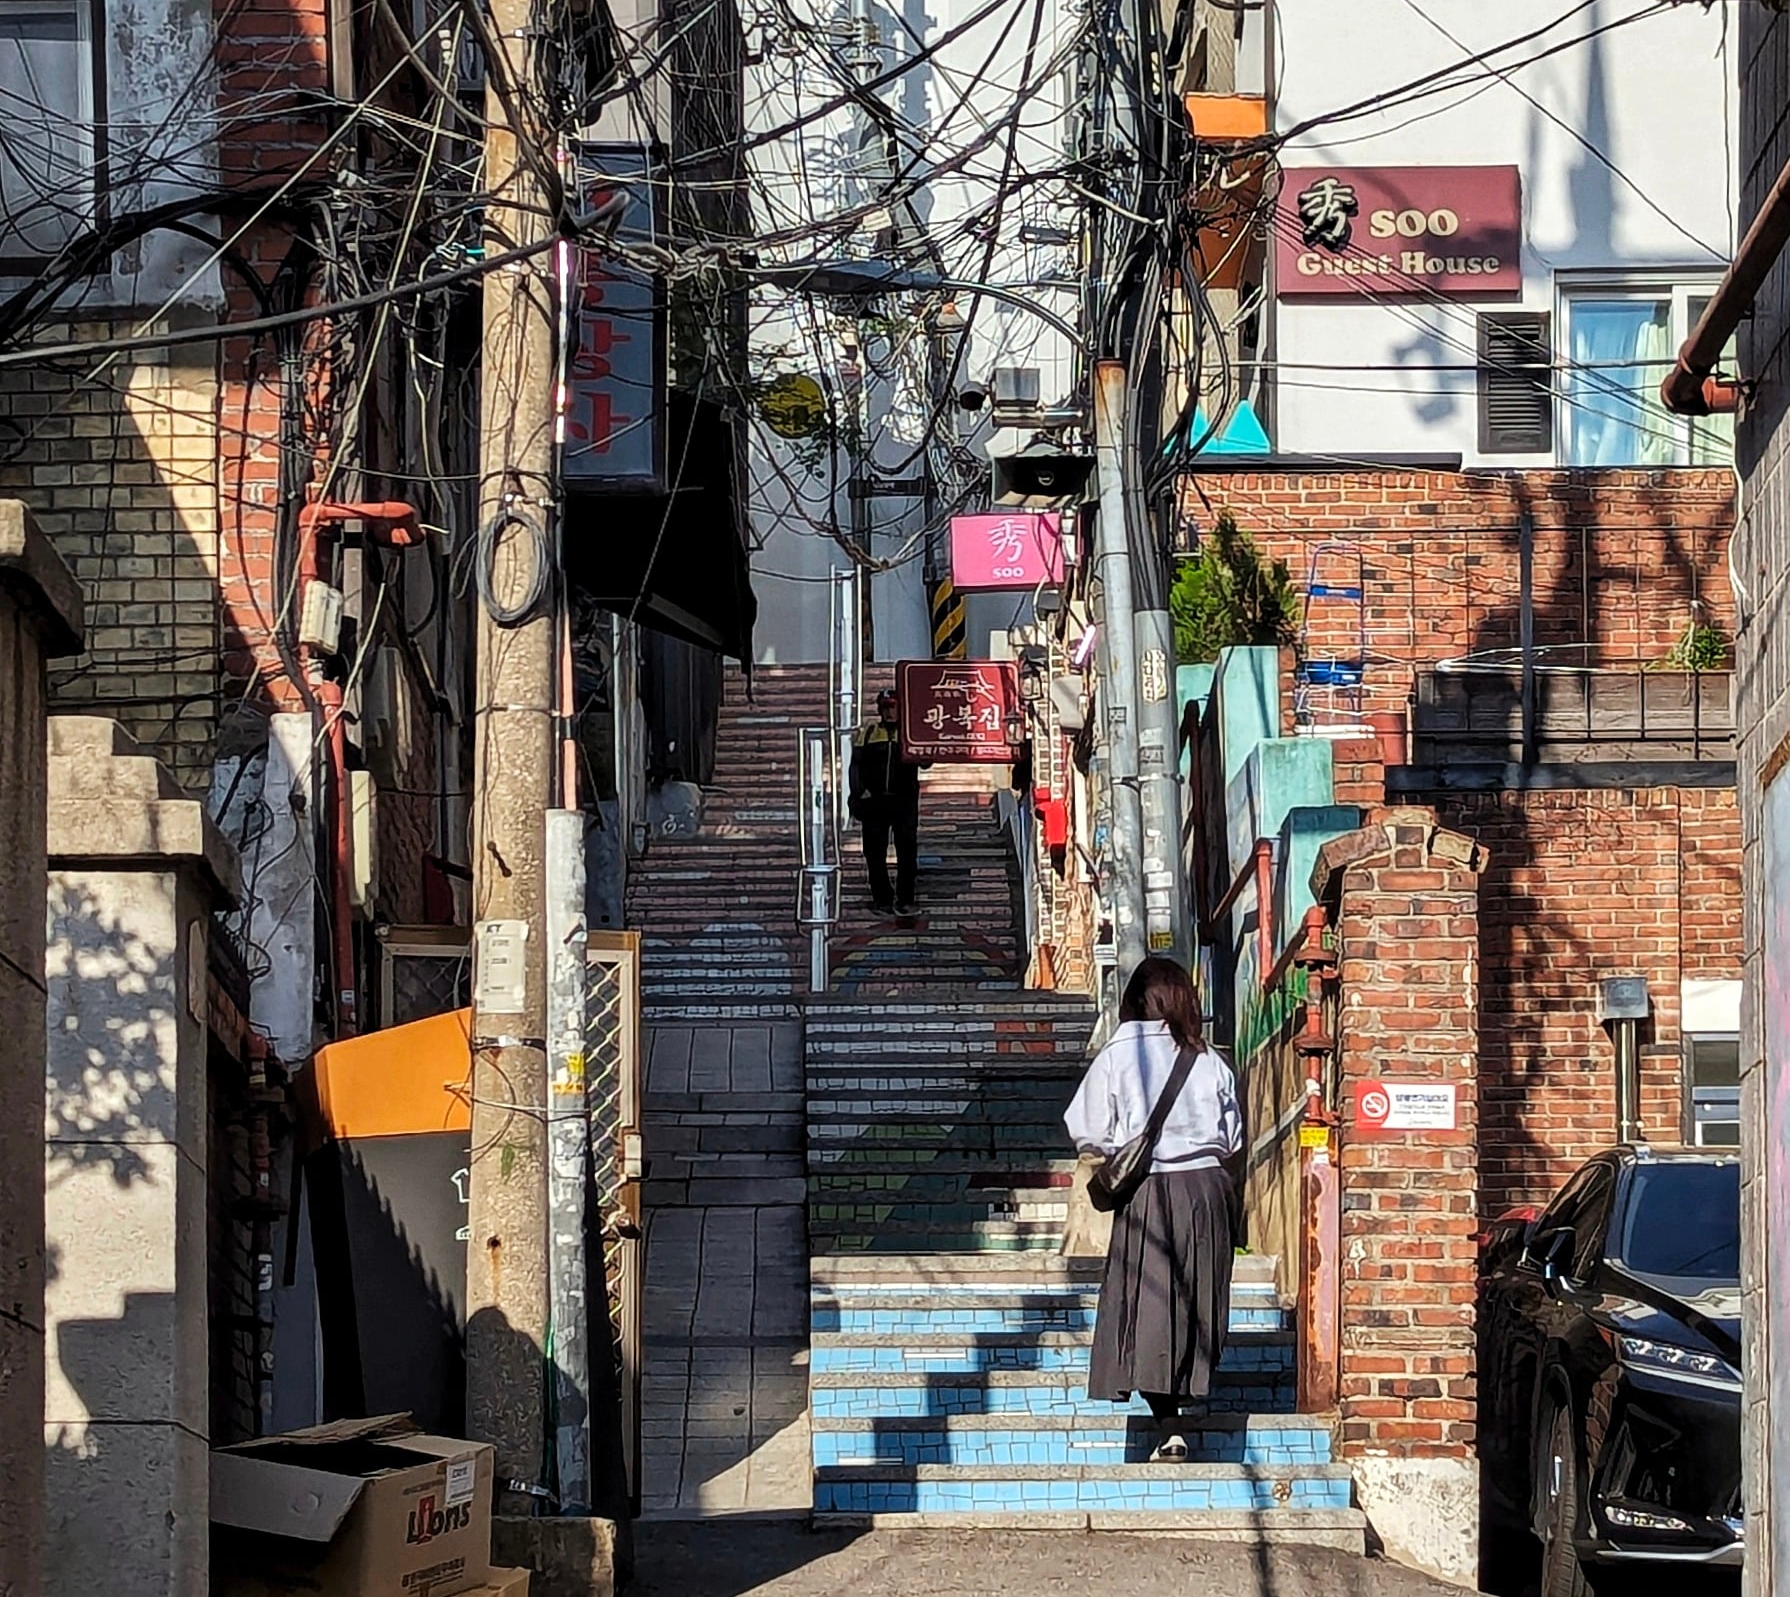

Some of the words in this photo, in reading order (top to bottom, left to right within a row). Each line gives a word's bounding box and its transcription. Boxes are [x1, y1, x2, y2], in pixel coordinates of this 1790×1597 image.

[1369, 208, 1459, 238] SOO
[1297, 250, 1393, 276] Guest
[1400, 250, 1499, 275] House
[987, 518, 1028, 563] 秀
